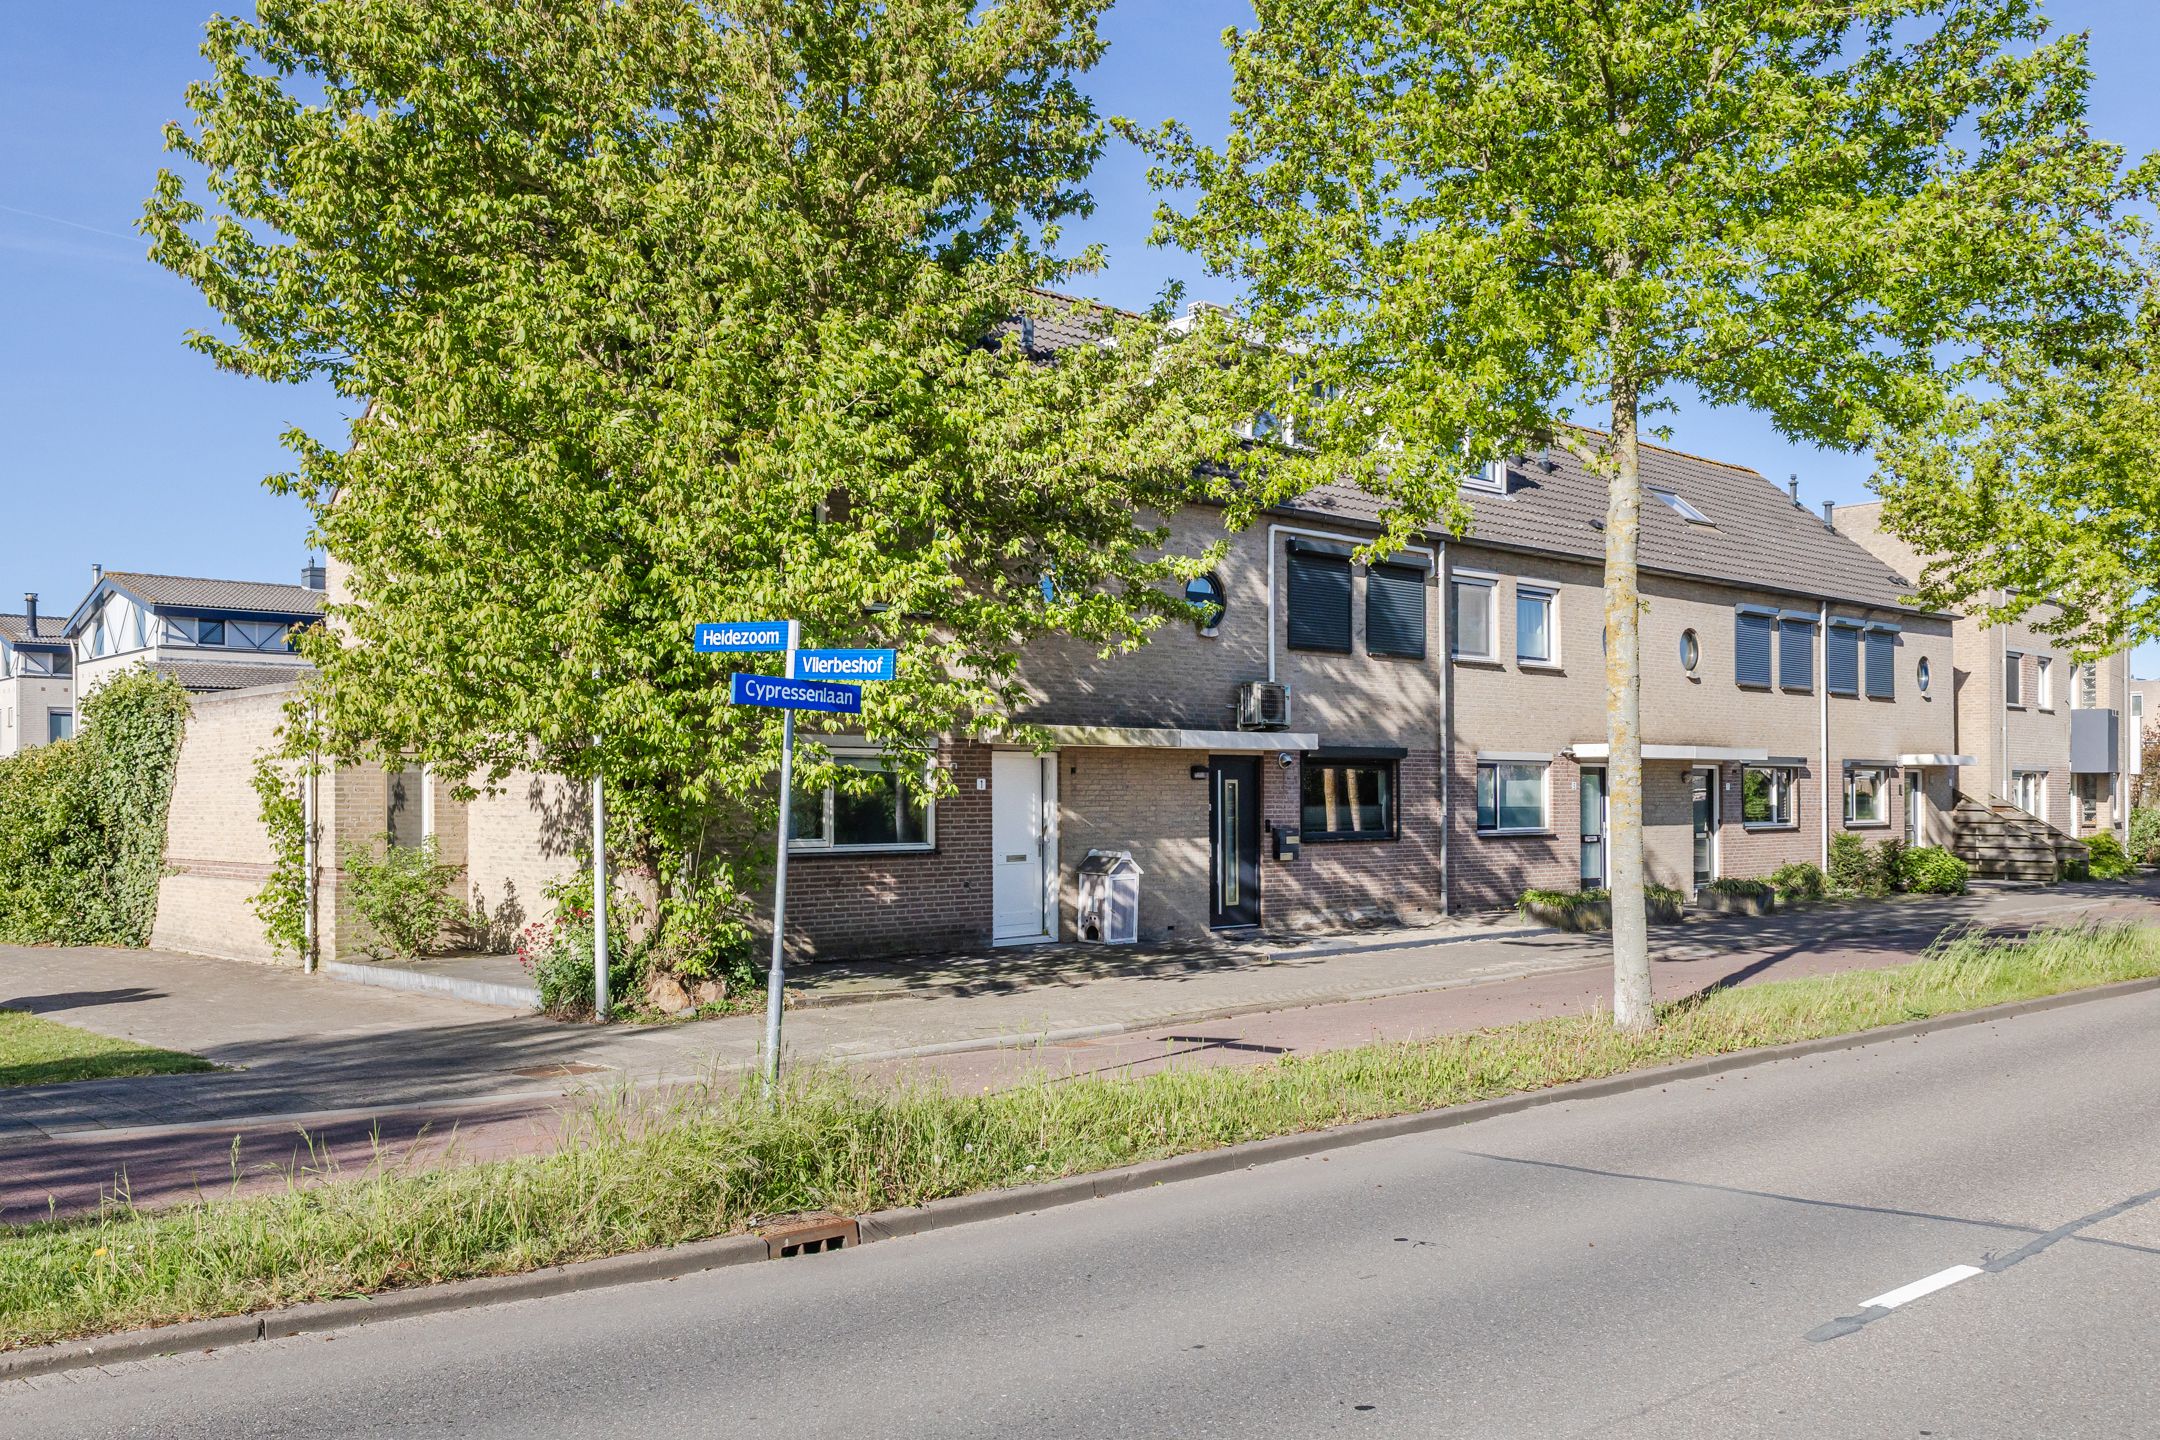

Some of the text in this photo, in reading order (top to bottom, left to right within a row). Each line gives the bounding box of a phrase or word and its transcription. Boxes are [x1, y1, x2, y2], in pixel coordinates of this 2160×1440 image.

[703, 629, 779, 646] Heidezoom
[802, 656, 883, 674] Vlierbeshof
[745, 679, 853, 705] Cypressenlaan
